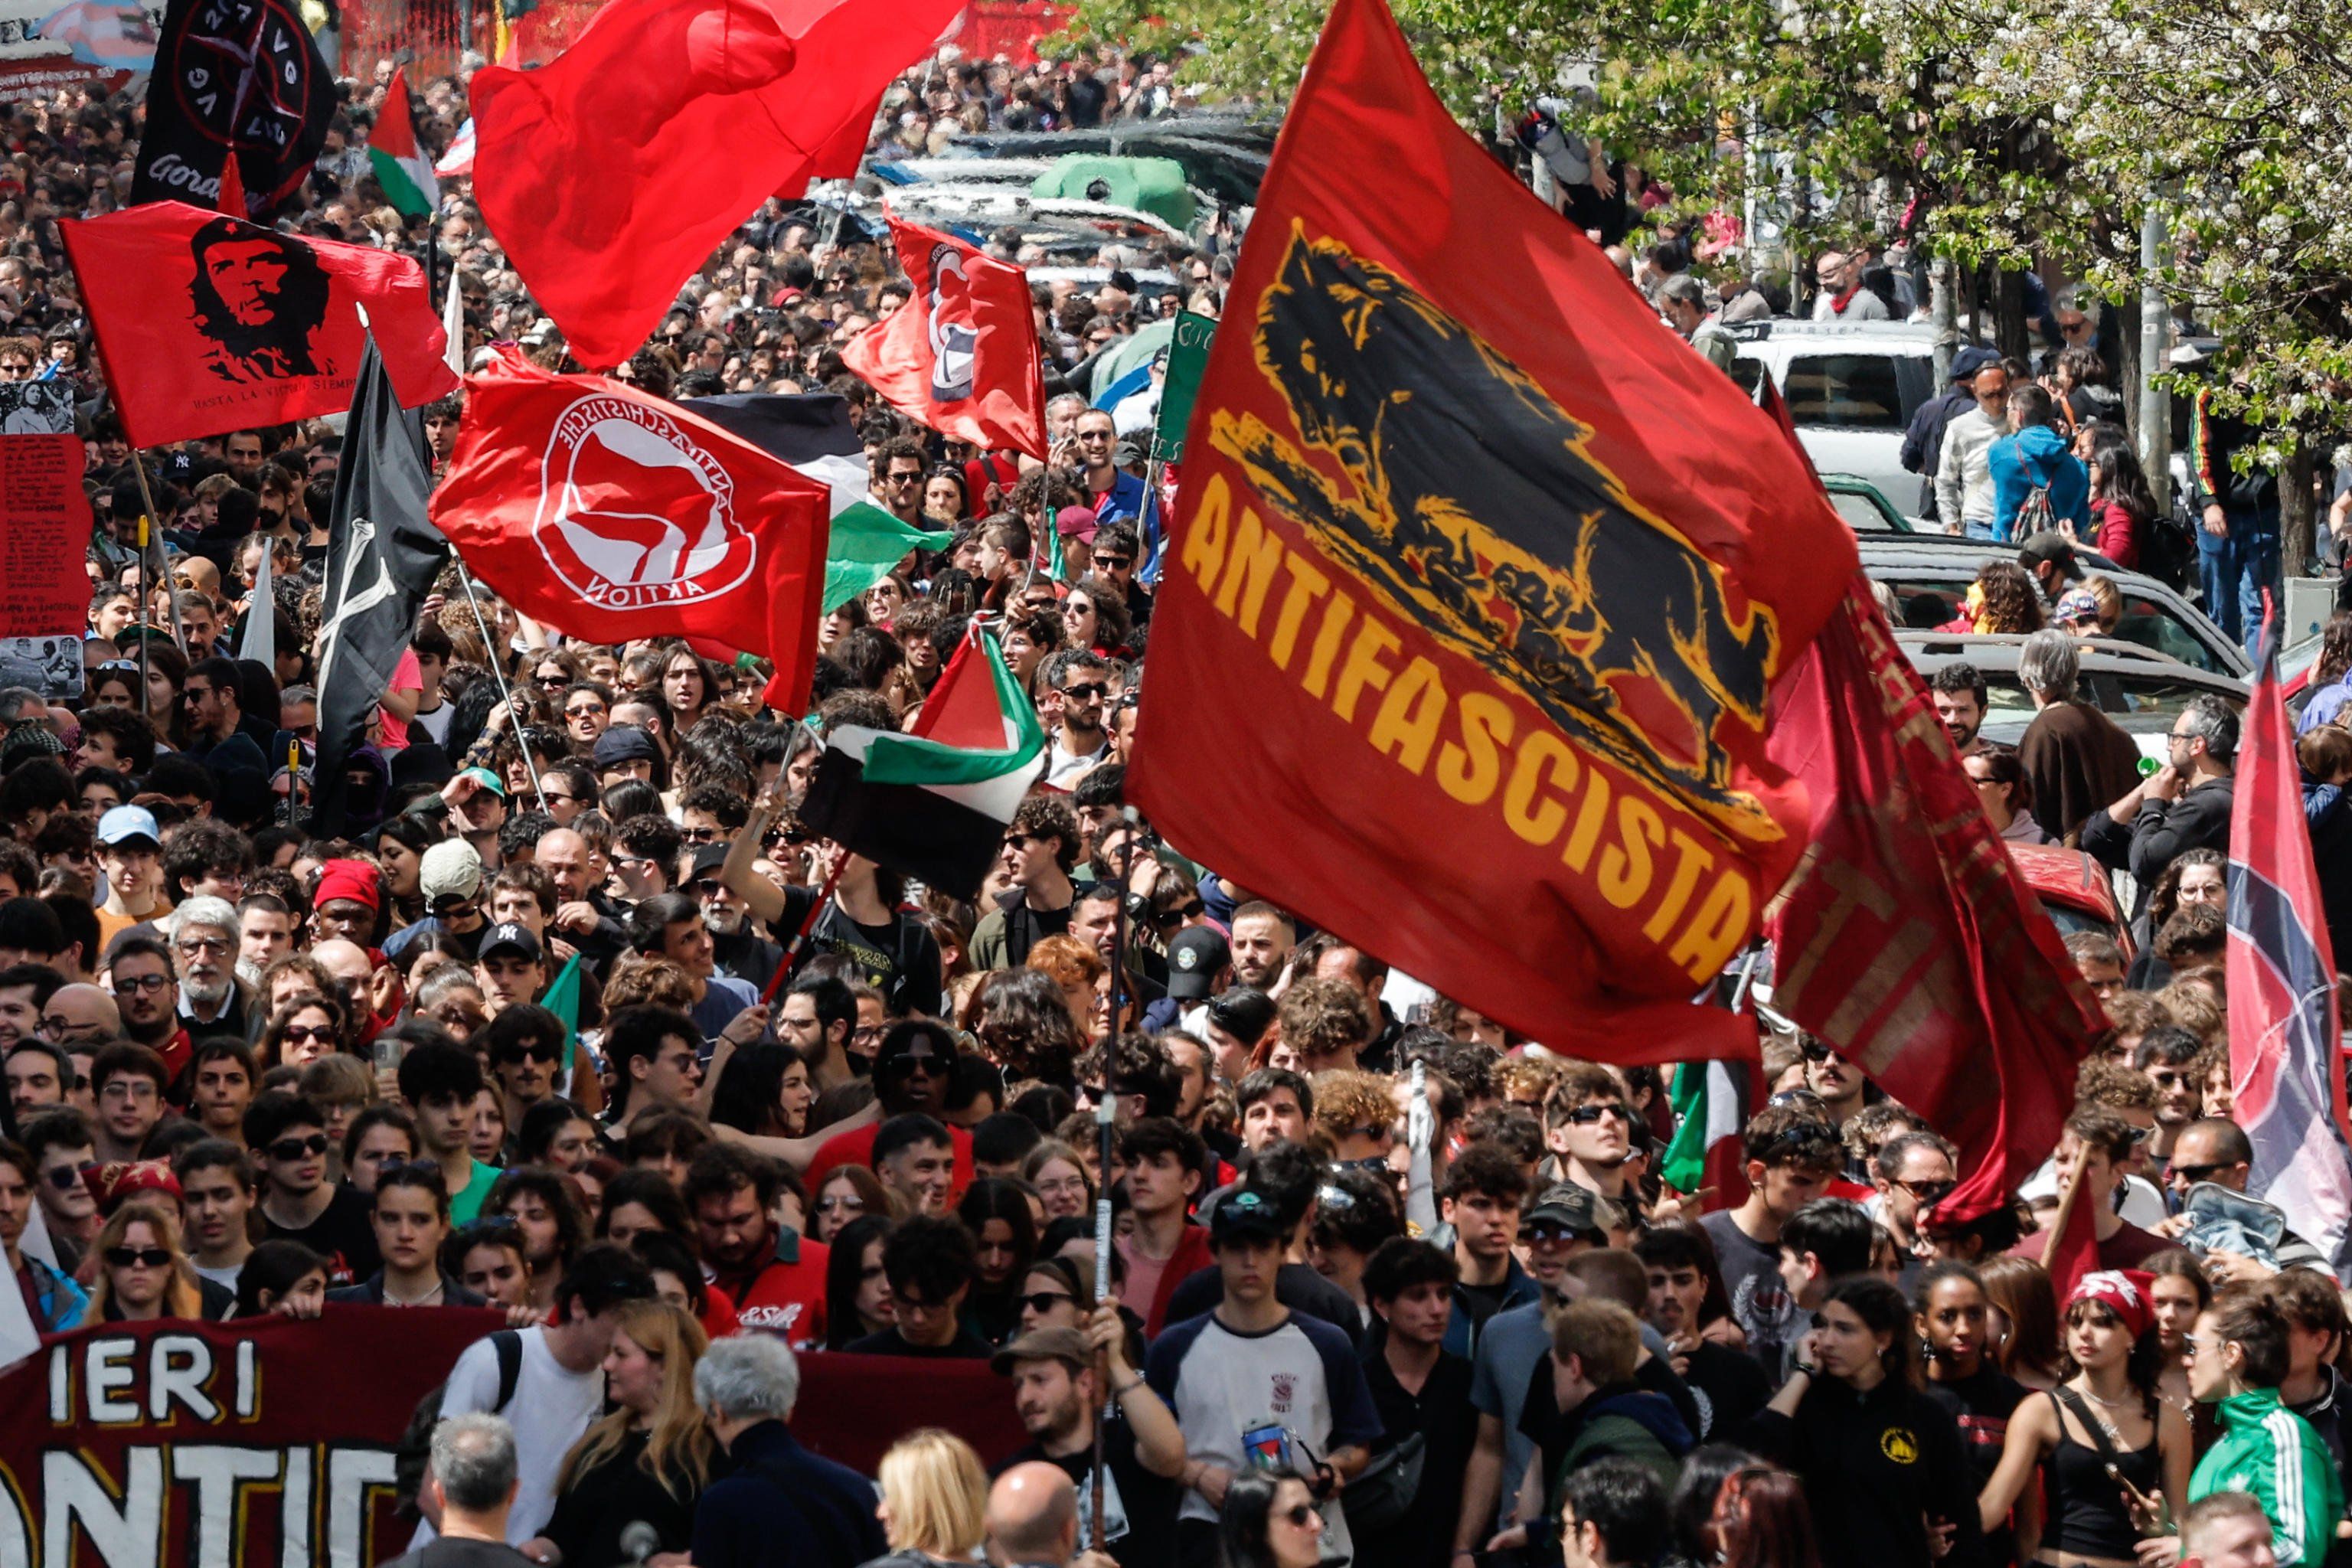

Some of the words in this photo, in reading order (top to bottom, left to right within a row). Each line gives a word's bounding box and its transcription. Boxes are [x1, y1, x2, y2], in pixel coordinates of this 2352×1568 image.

[193, 395, 234, 410] HASTA
[241, 390, 258, 402] LA
[176, 455, 190, 468] NY
[1182, 472, 1752, 985] ANTIFASCISTA
[498, 924, 518, 940] NY
[49, 1334, 260, 1424] IERI
